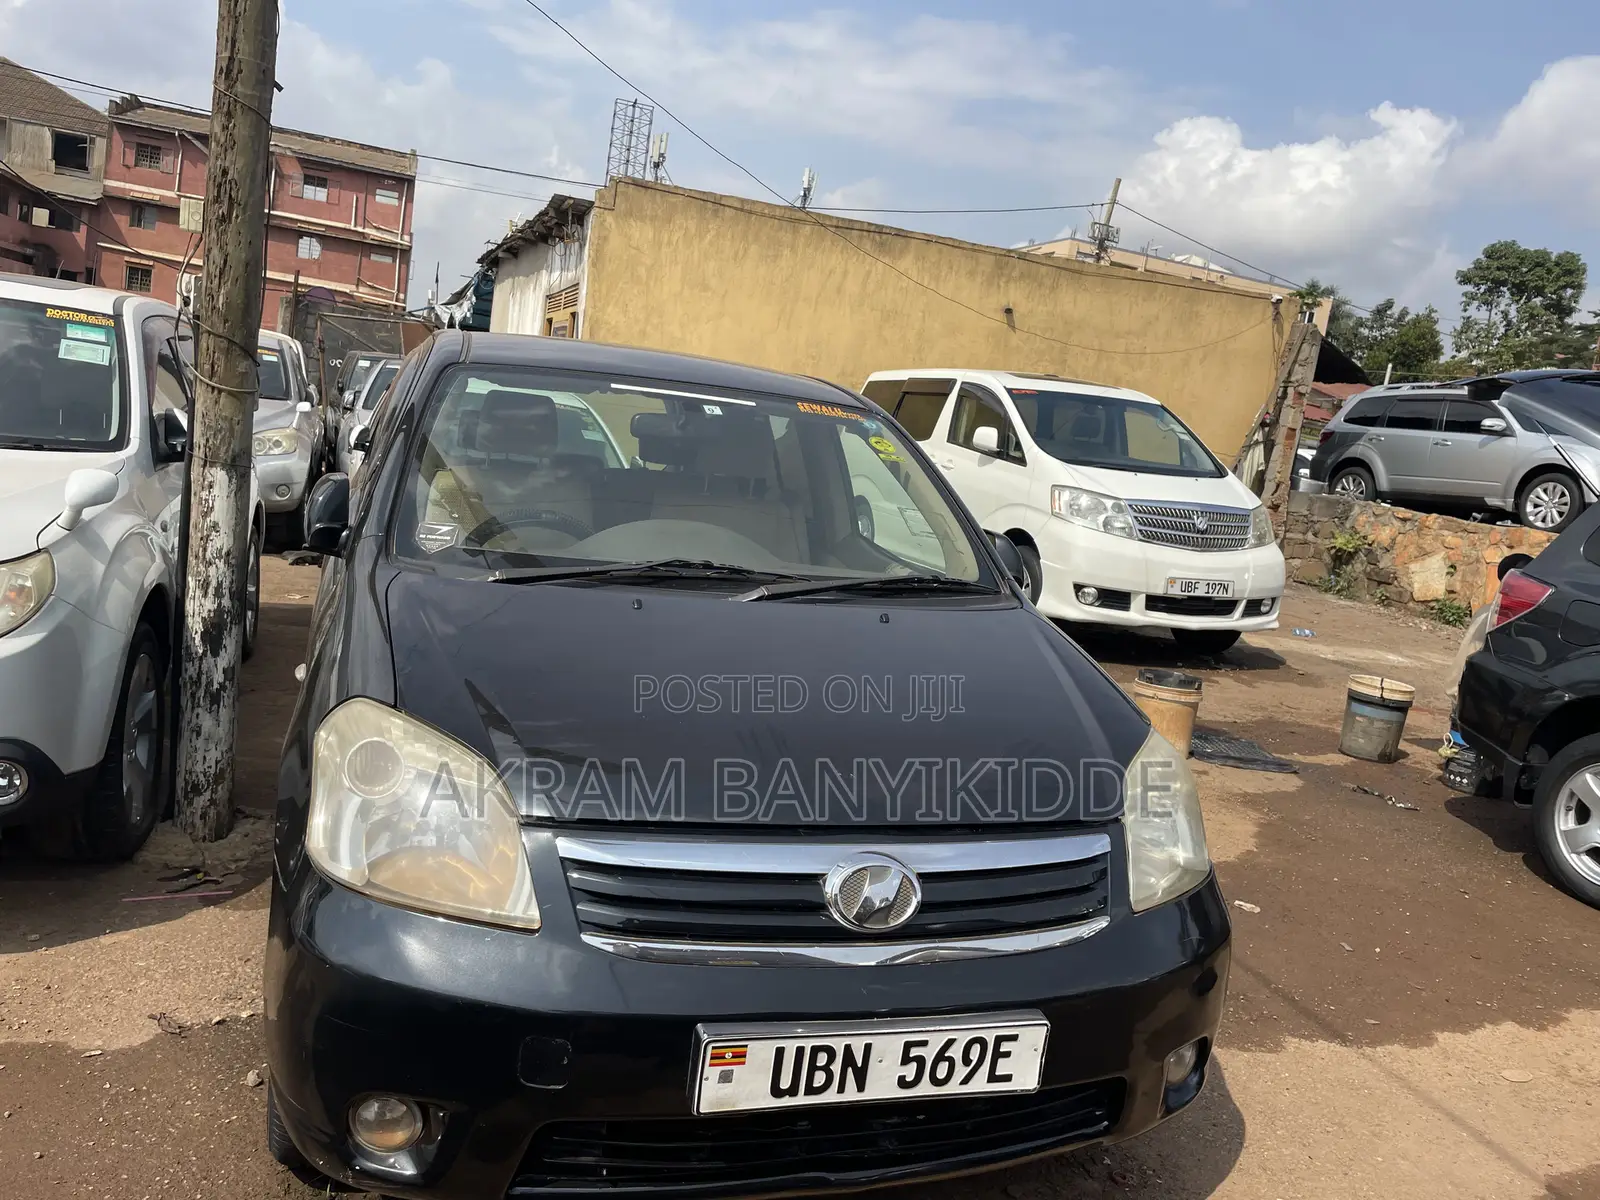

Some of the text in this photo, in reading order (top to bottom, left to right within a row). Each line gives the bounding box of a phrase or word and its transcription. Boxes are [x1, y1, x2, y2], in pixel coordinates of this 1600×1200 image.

[46, 308, 87, 321] DOCTOR
[1180, 580, 1230, 595] UBF 197N
[769, 1033, 1020, 1099] UBN 569E
